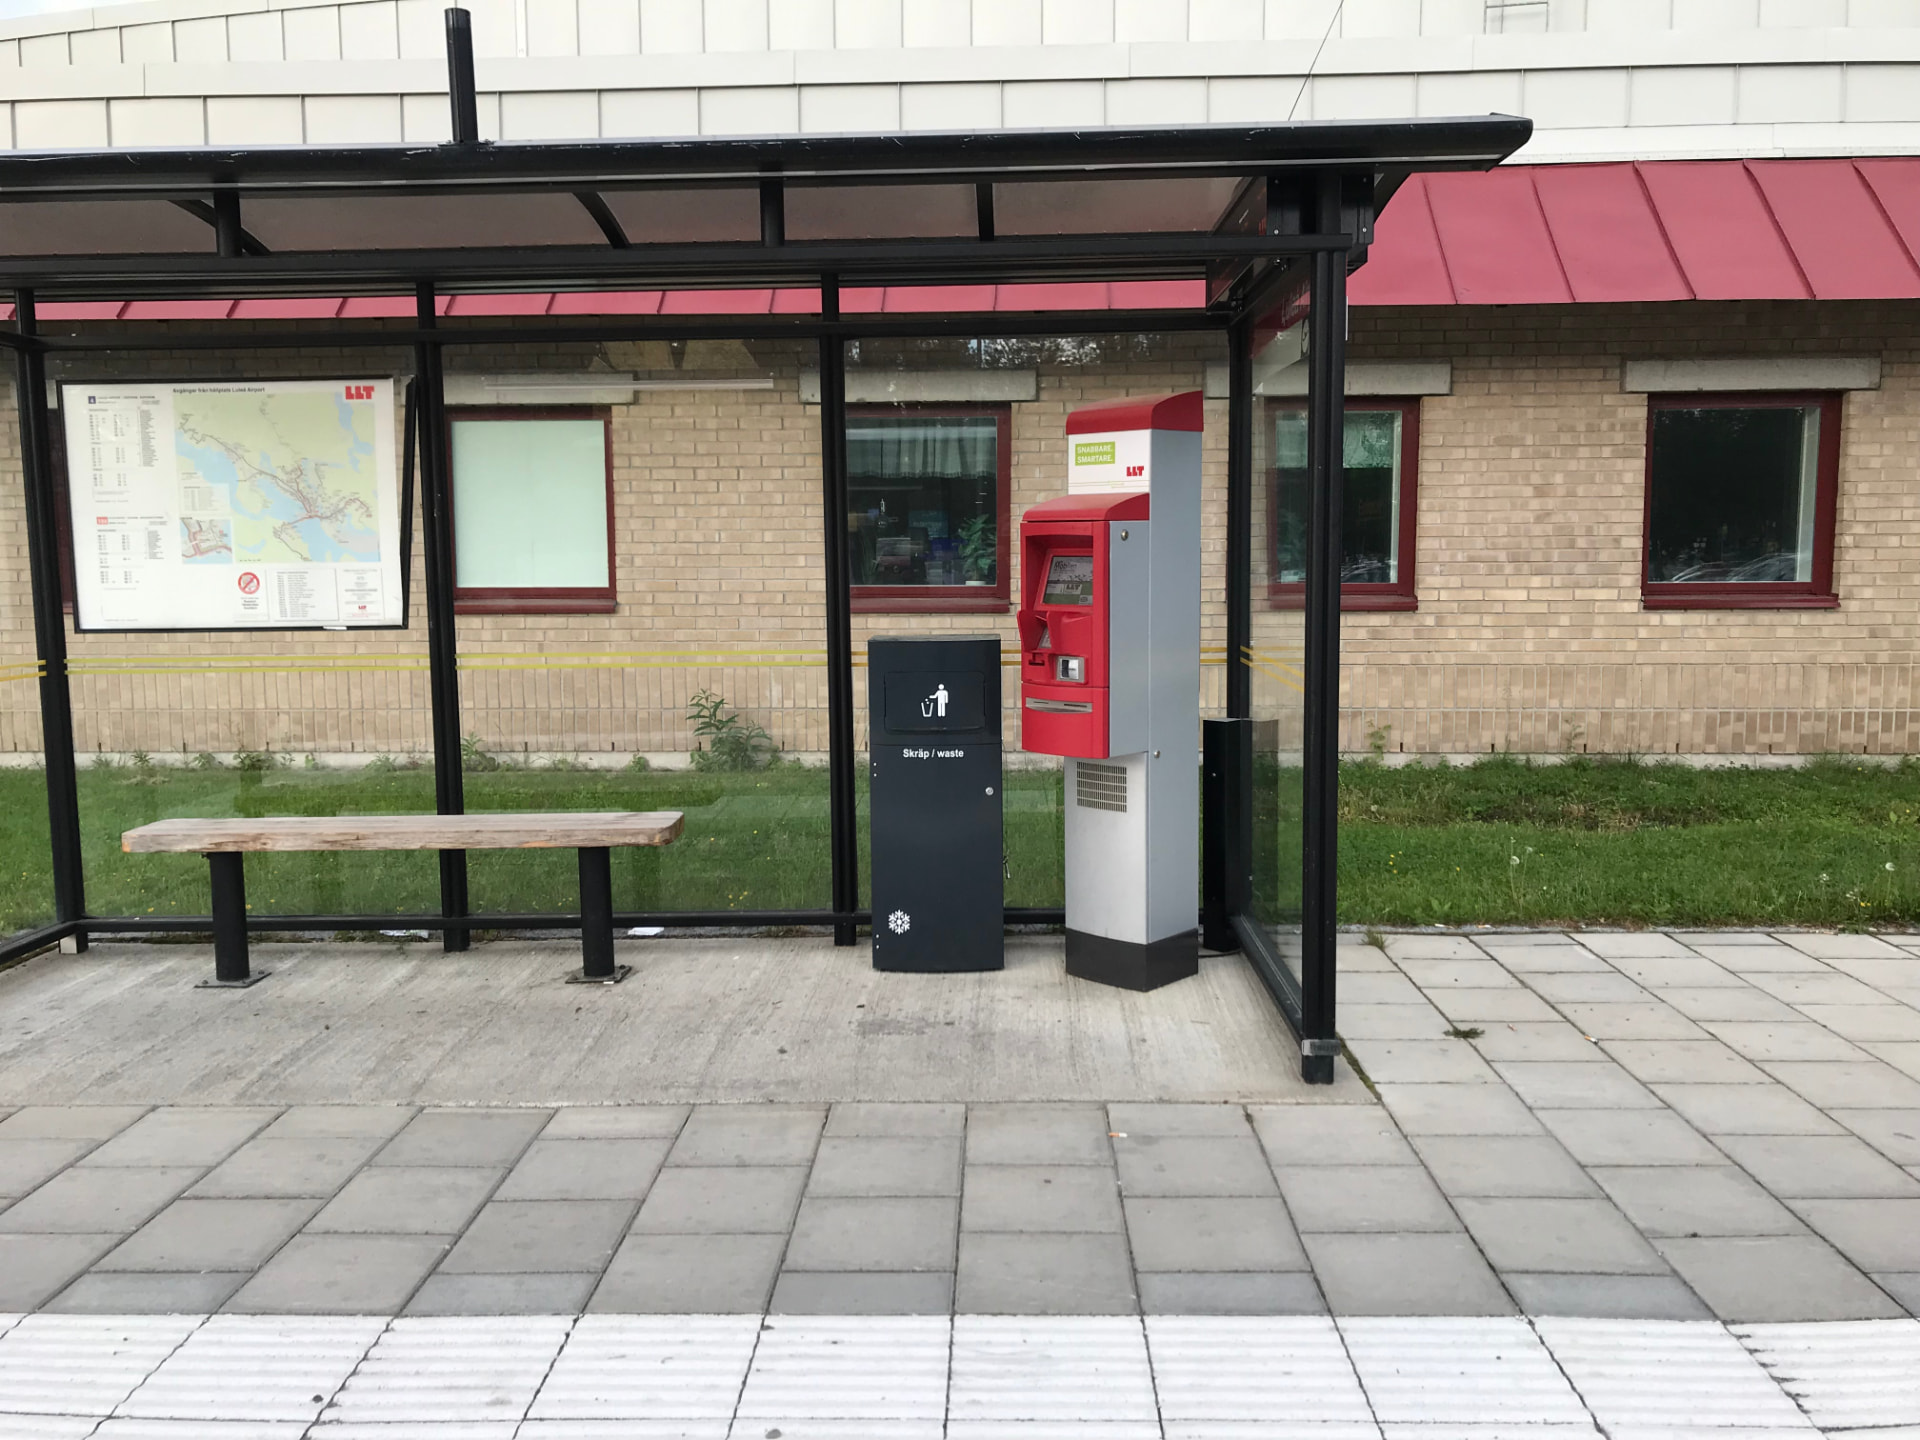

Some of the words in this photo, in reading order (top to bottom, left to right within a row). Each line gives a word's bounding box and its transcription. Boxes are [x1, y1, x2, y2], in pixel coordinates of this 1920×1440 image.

[345, 385, 375, 400] LLT
[1077, 454, 1113, 464] SMARTARE.
[1126, 466, 1145, 477] LLT
[903, 748, 930, 760] Skräp
[936, 748, 964, 758] waste
